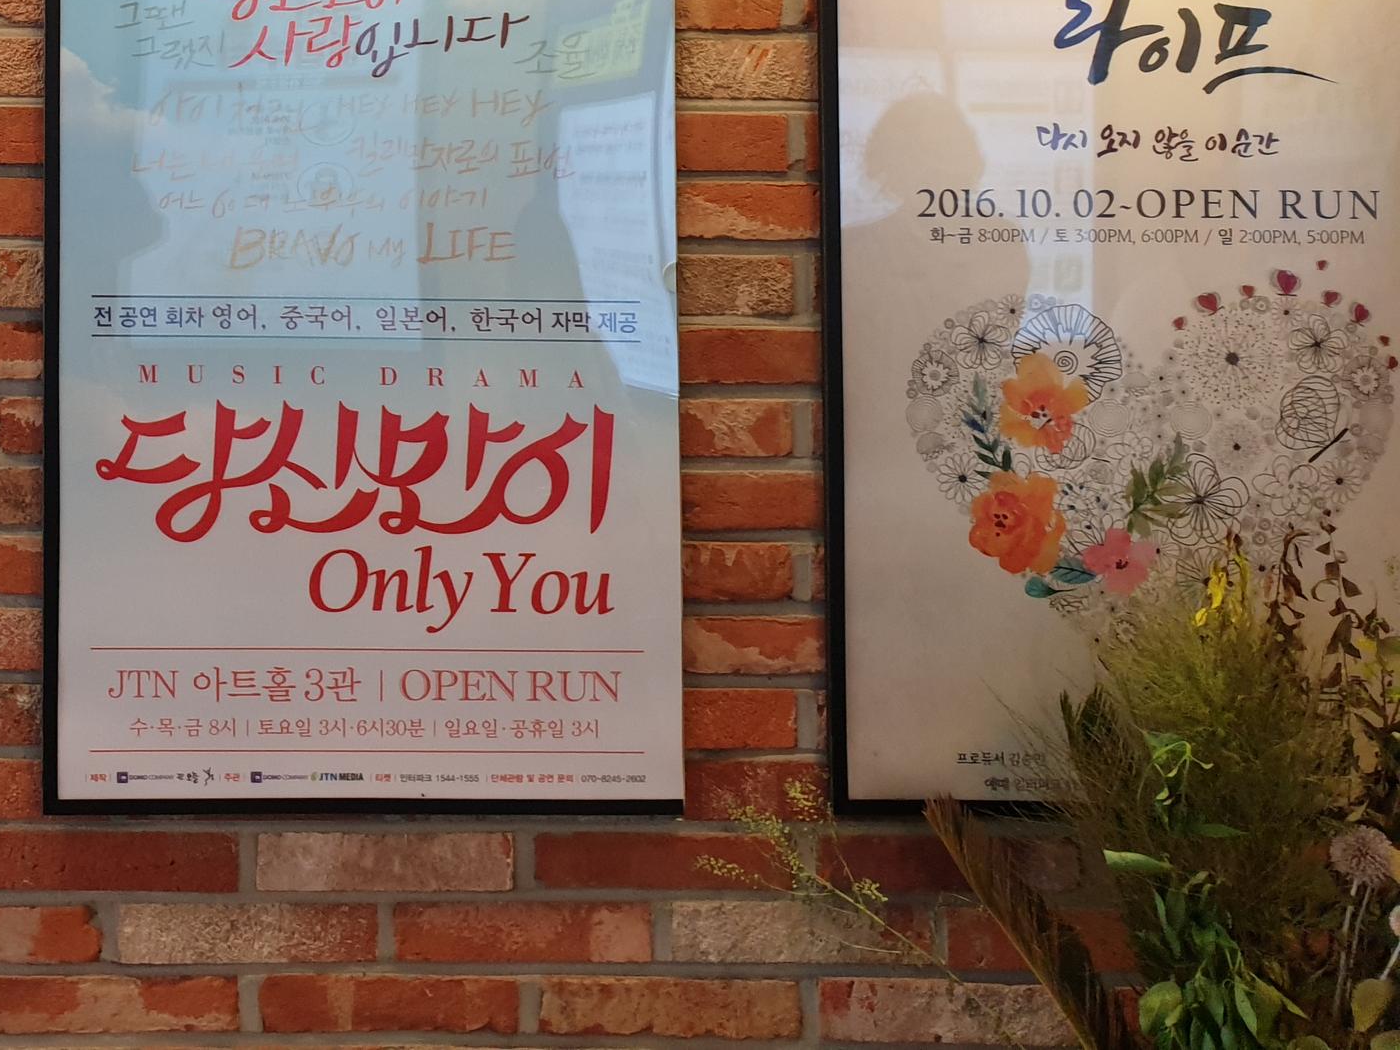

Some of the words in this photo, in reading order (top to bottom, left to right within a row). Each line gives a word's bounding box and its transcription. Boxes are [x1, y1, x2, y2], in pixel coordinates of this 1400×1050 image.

[227, 12, 529, 78] 사랑입니다
[513, 30, 596, 79] 조율
[401, 91, 458, 118] HEY
[471, 87, 553, 127] HEY
[507, 139, 576, 180] 표범
[1035, 123, 1088, 151] 다시
[1097, 124, 1140, 157] 오지
[1153, 125, 1199, 162] 않을
[400, 185, 487, 210] 이야기
[1279, 190, 1380, 221] RUN
[228, 222, 361, 270] BRAVO
[416, 221, 516, 265] LIFE
[977, 228, 1035, 244] 8:00PM
[1055, 229, 1069, 244] 토
[1141, 229, 1199, 245] 6:00PM
[1218, 229, 1233, 246] 일
[1306, 230, 1365, 246] 5:00PM
[94, 305, 113, 328] 전
[119, 305, 157, 328] 공연
[165, 305, 204, 328] 회차
[212, 304, 267, 330] 영어,
[280, 305, 361, 330] 중국어,
[376, 305, 456, 332] 일본어,
[470, 306, 543, 333] 한국어
[551, 311, 591, 334] 자막
[597, 311, 637, 334] 제공
[138, 364, 326, 386] MUSIC
[379, 366, 585, 389] DRAMA
[95, 399, 615, 543] 당신만이
[308, 545, 474, 633] Only
[483, 551, 615, 615] You
[108, 669, 178, 699] JTN
[193, 666, 297, 702] 아트홀
[303, 667, 362, 702] 3관
[400, 668, 518, 702] OPEN
[526, 670, 622, 702] RUN
[209, 718, 236, 737] 8시
[258, 717, 312, 737] 토요일
[571, 718, 600, 738] 3시
[319, 772, 338, 781] JTN
[339, 772, 364, 781] MEDIA
[956, 751, 1006, 766] 프로듀서
